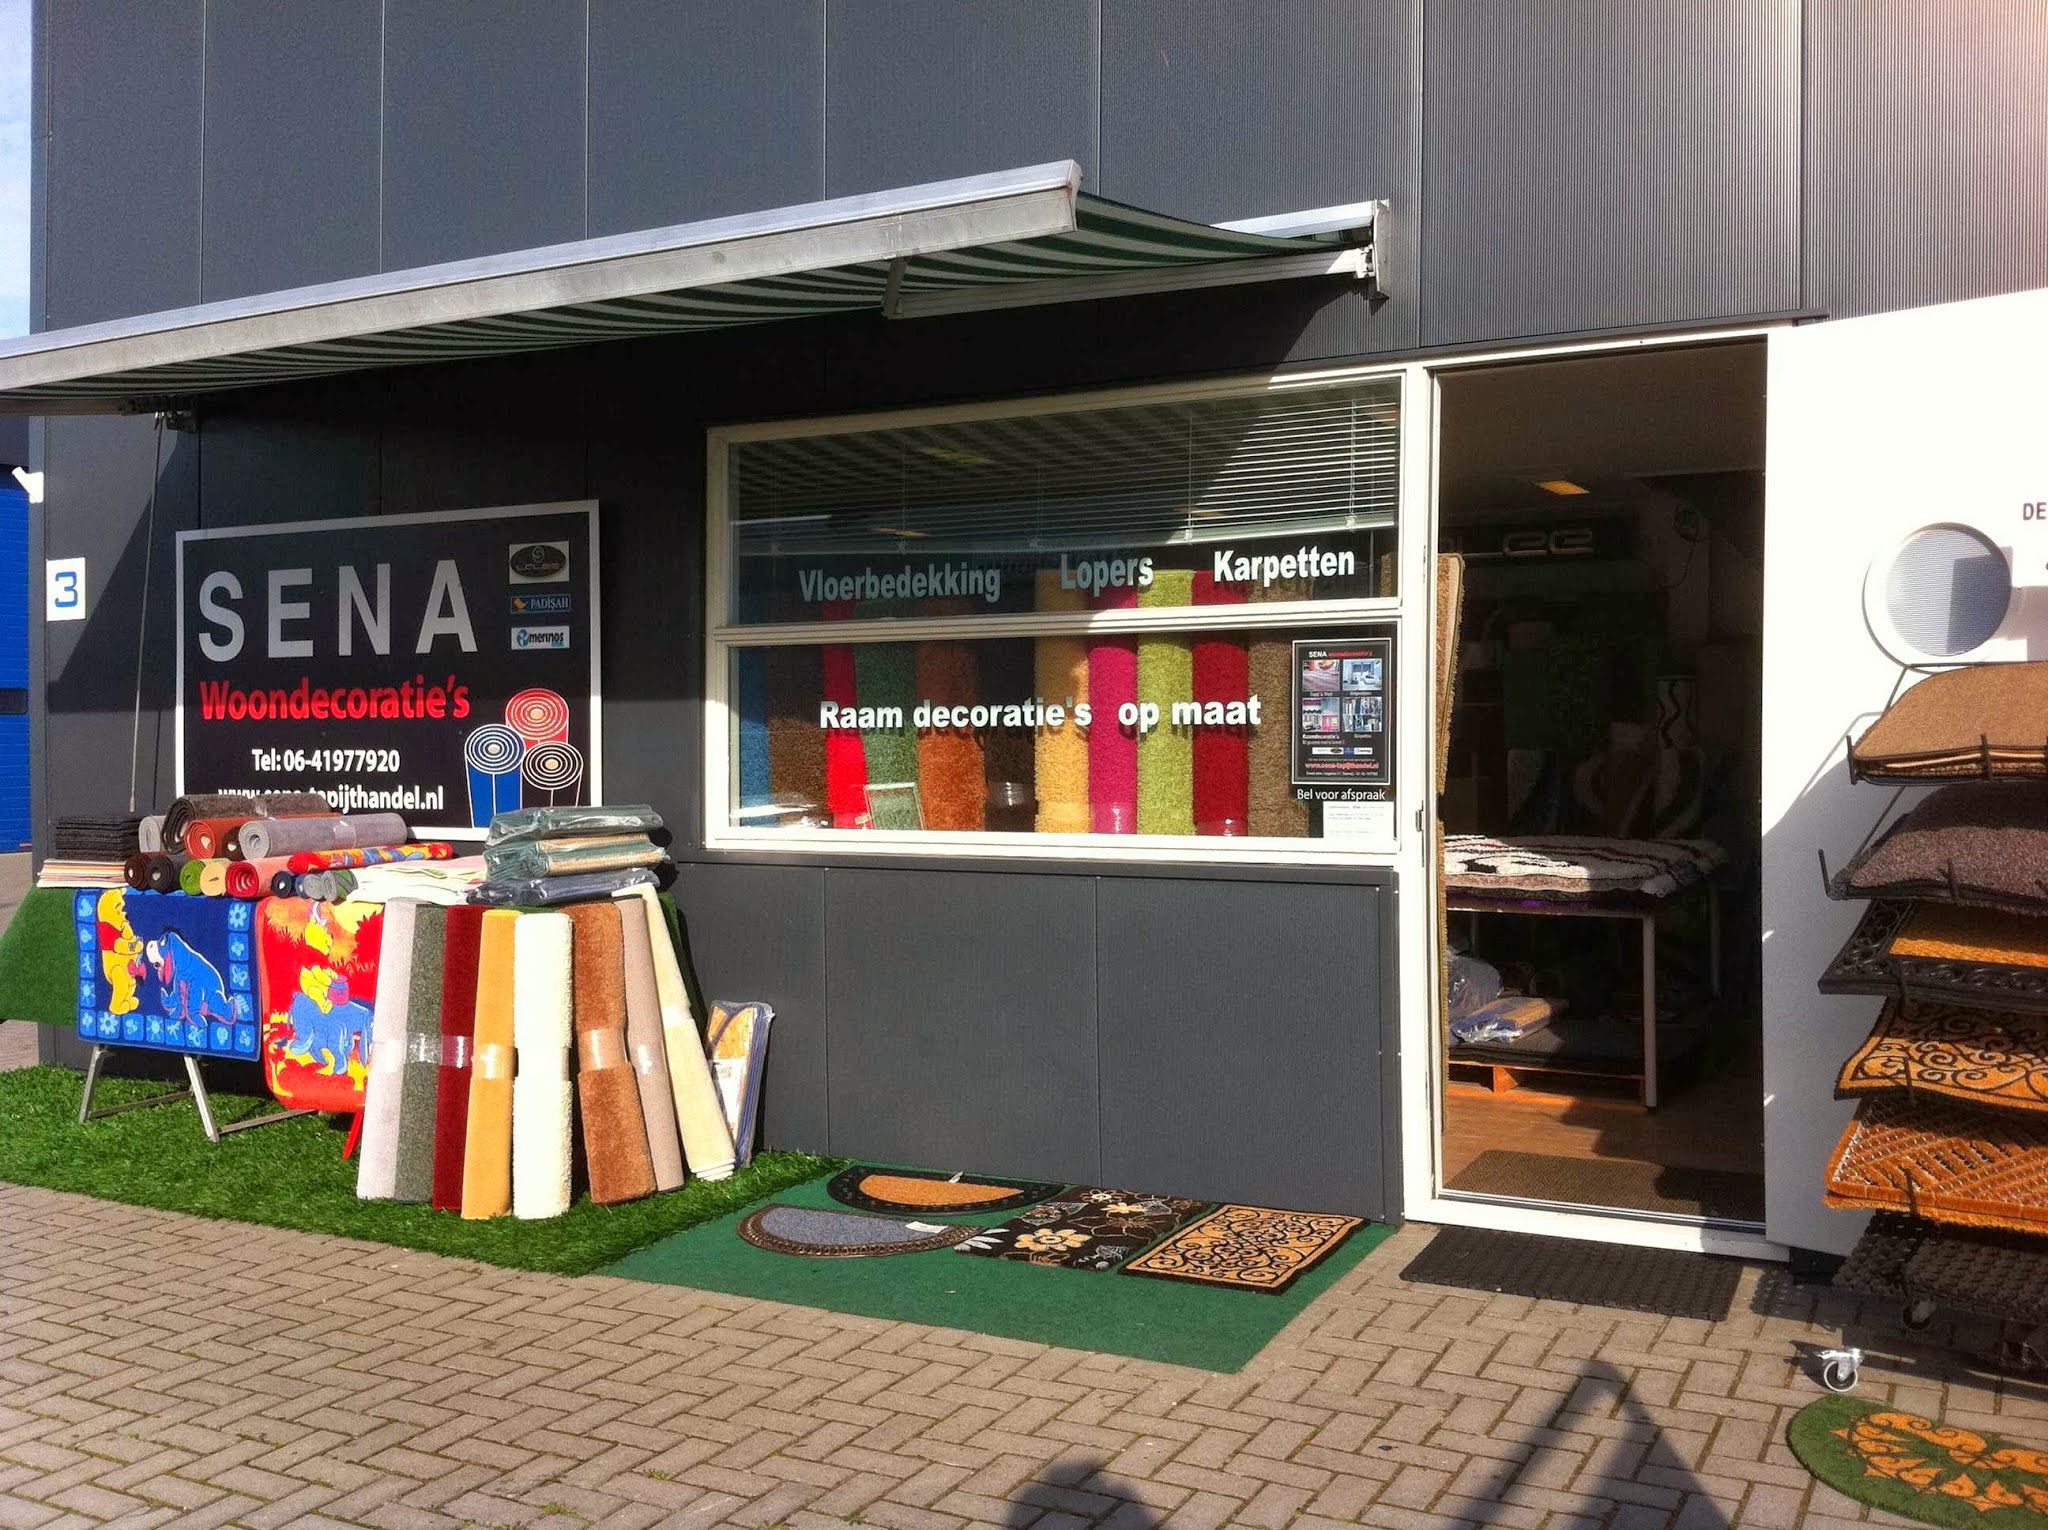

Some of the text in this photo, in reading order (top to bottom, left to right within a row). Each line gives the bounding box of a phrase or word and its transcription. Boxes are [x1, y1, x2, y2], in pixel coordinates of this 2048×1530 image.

[799, 562, 1002, 603] Vloerbedekking
[1060, 553, 1154, 598] Lopers
[1213, 546, 1356, 588] Karpetten
[55, 571, 78, 607] 3
[198, 559, 479, 663] SENA
[528, 631, 564, 643] merinos
[1308, 650, 1328, 658] SENA
[200, 674, 471, 720] Woondecoratie's
[820, 694, 1262, 732] Raam decoratie's op maat
[252, 748, 400, 773] Tel: 06-41977920
[1297, 788, 1386, 802] Bel voor afspraak
